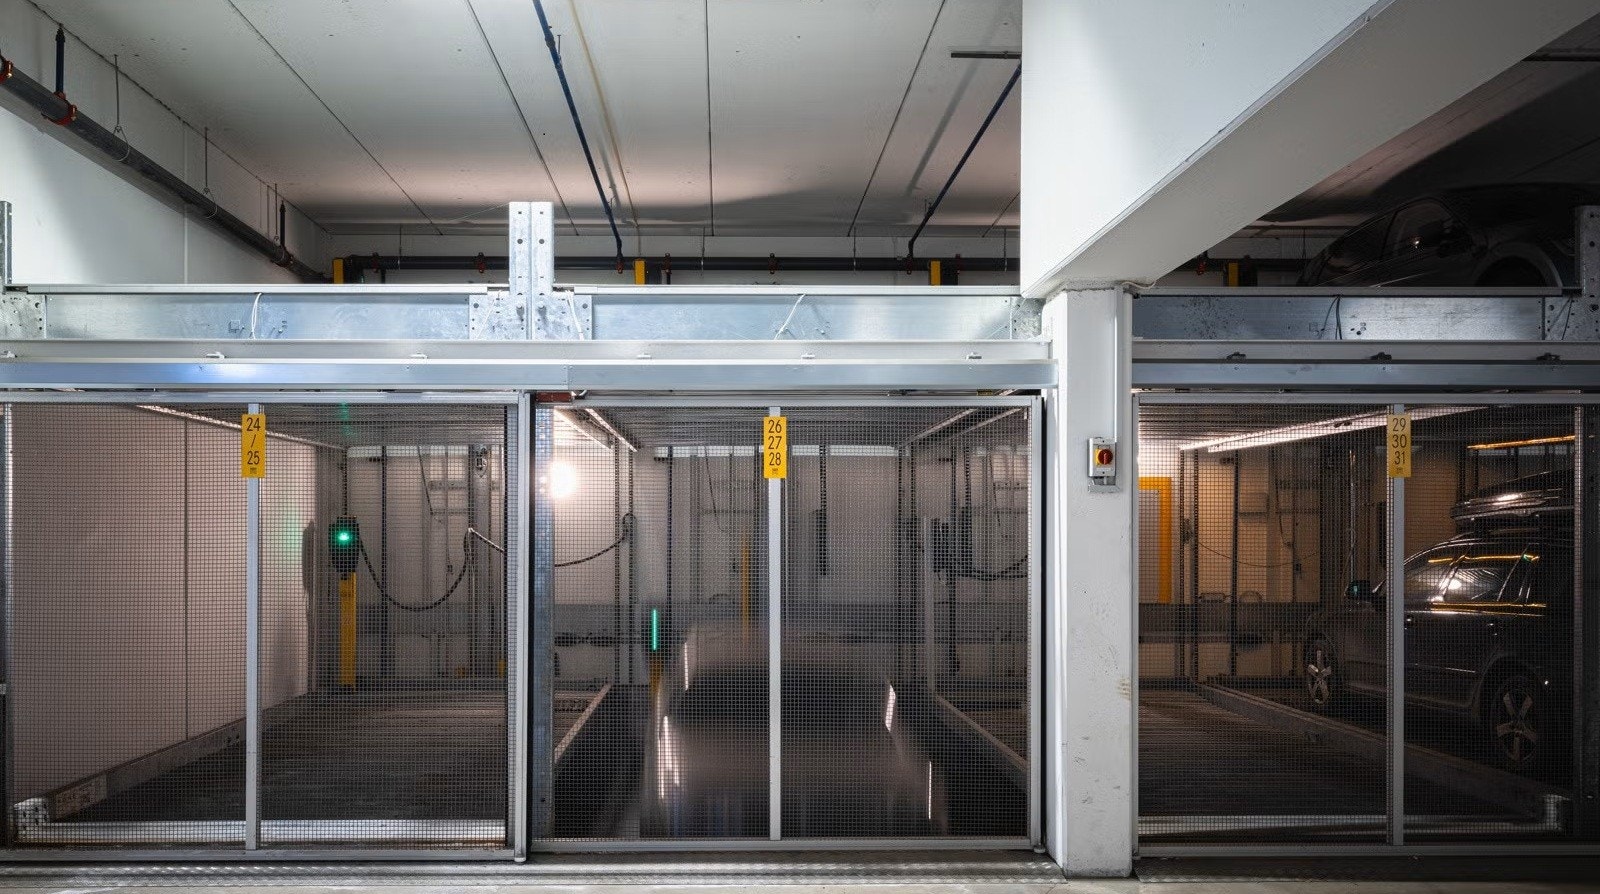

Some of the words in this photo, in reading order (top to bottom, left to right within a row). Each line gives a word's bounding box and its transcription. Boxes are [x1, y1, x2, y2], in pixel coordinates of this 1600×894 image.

[246, 417, 261, 431] 24
[768, 419, 782, 433] 26
[1392, 417, 1406, 431] 29
[768, 436, 782, 449] 27
[1392, 434, 1407, 448] 30
[247, 450, 260, 465] 25
[769, 452, 782, 466] 28
[1394, 450, 1406, 464] 31
